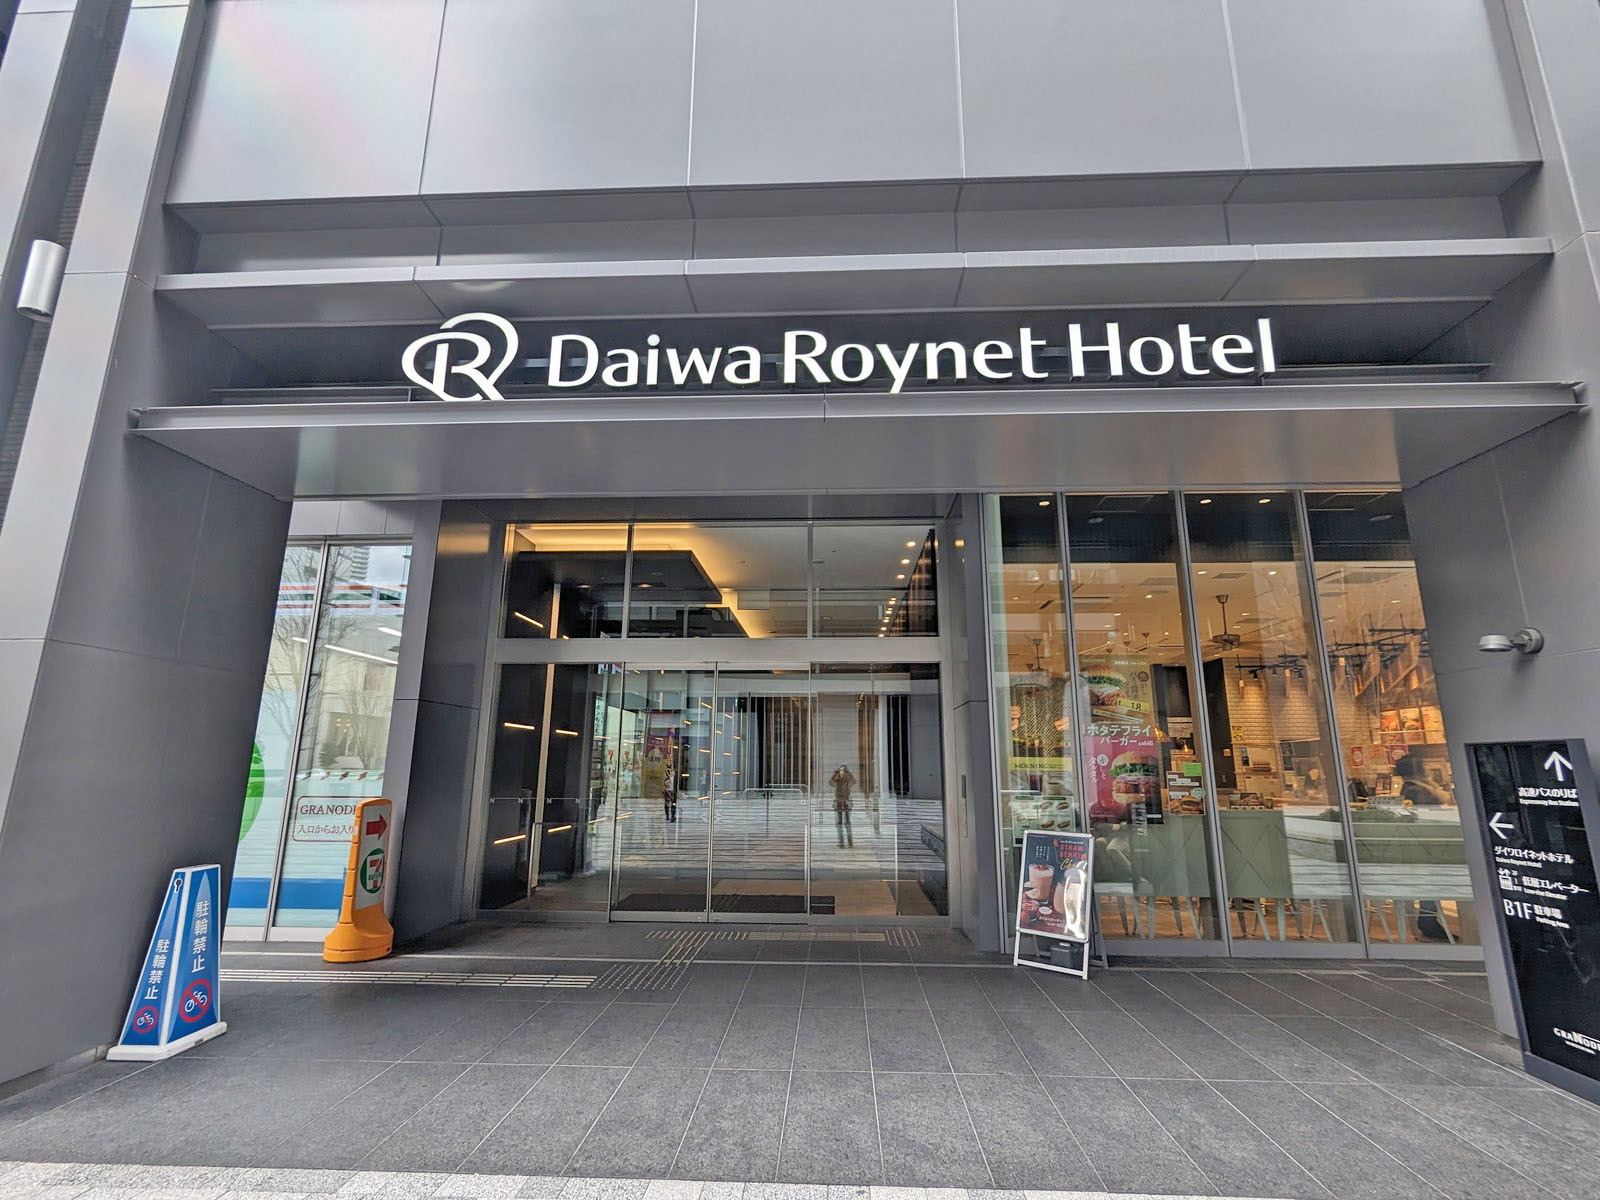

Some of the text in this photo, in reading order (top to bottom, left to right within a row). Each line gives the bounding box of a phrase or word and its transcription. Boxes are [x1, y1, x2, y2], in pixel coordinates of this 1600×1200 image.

[547, 318, 1276, 394] Daiwa Roynet Hotel
[1087, 725, 1152, 736] ホタテフライ
[1100, 736, 1137, 746] バーガー
[1494, 846, 1574, 864] ダイワロイネットホテル
[1503, 899, 1533, 919] B1F
[191, 900, 210, 974] 駐輪禁止
[144, 938, 170, 1000] 駐輪禁止
